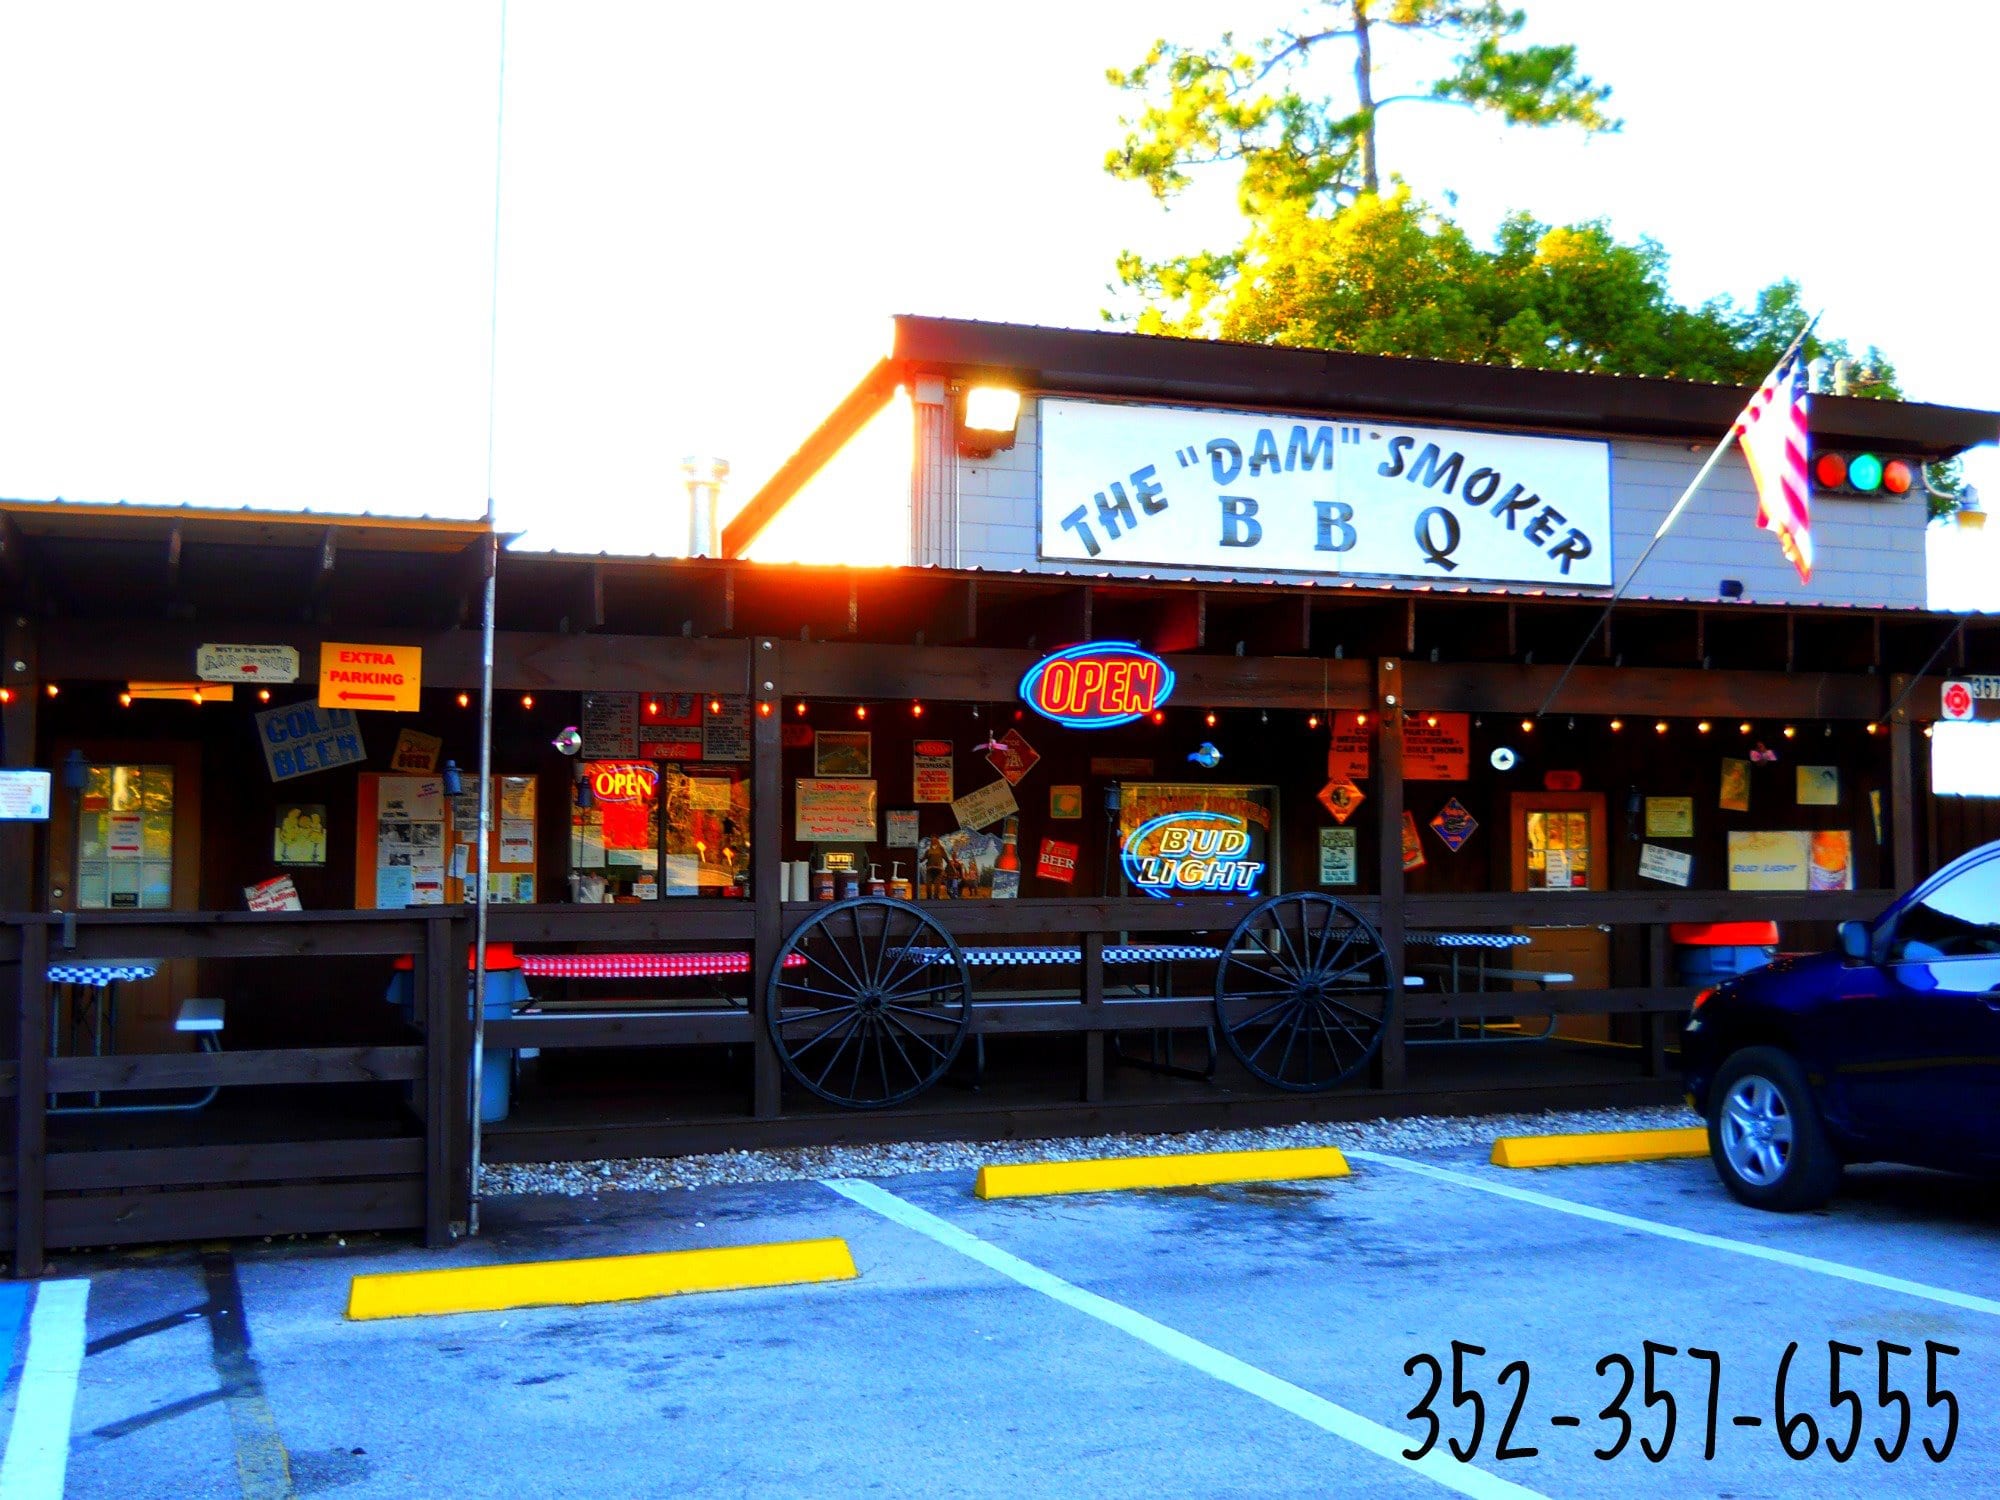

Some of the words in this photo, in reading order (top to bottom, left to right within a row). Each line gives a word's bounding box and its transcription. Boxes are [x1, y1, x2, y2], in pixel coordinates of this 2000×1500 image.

[1060, 463, 1169, 557] THE
[1175, 424, 1360, 486] "DAM"
[1377, 435, 1594, 576] SMOKER
[339, 650, 395, 667] EXTRA
[329, 670, 404, 686] PARKING
[1041, 661, 1157, 713] OPEN
[595, 772, 651, 796] OPEN
[1159, 827, 1249, 857] BUD
[1039, 853, 1075, 870] BEER
[1136, 857, 1264, 889] LIGHT
[1731, 864, 1761, 873] BUD
[1763, 863, 1798, 873] LIGHT
